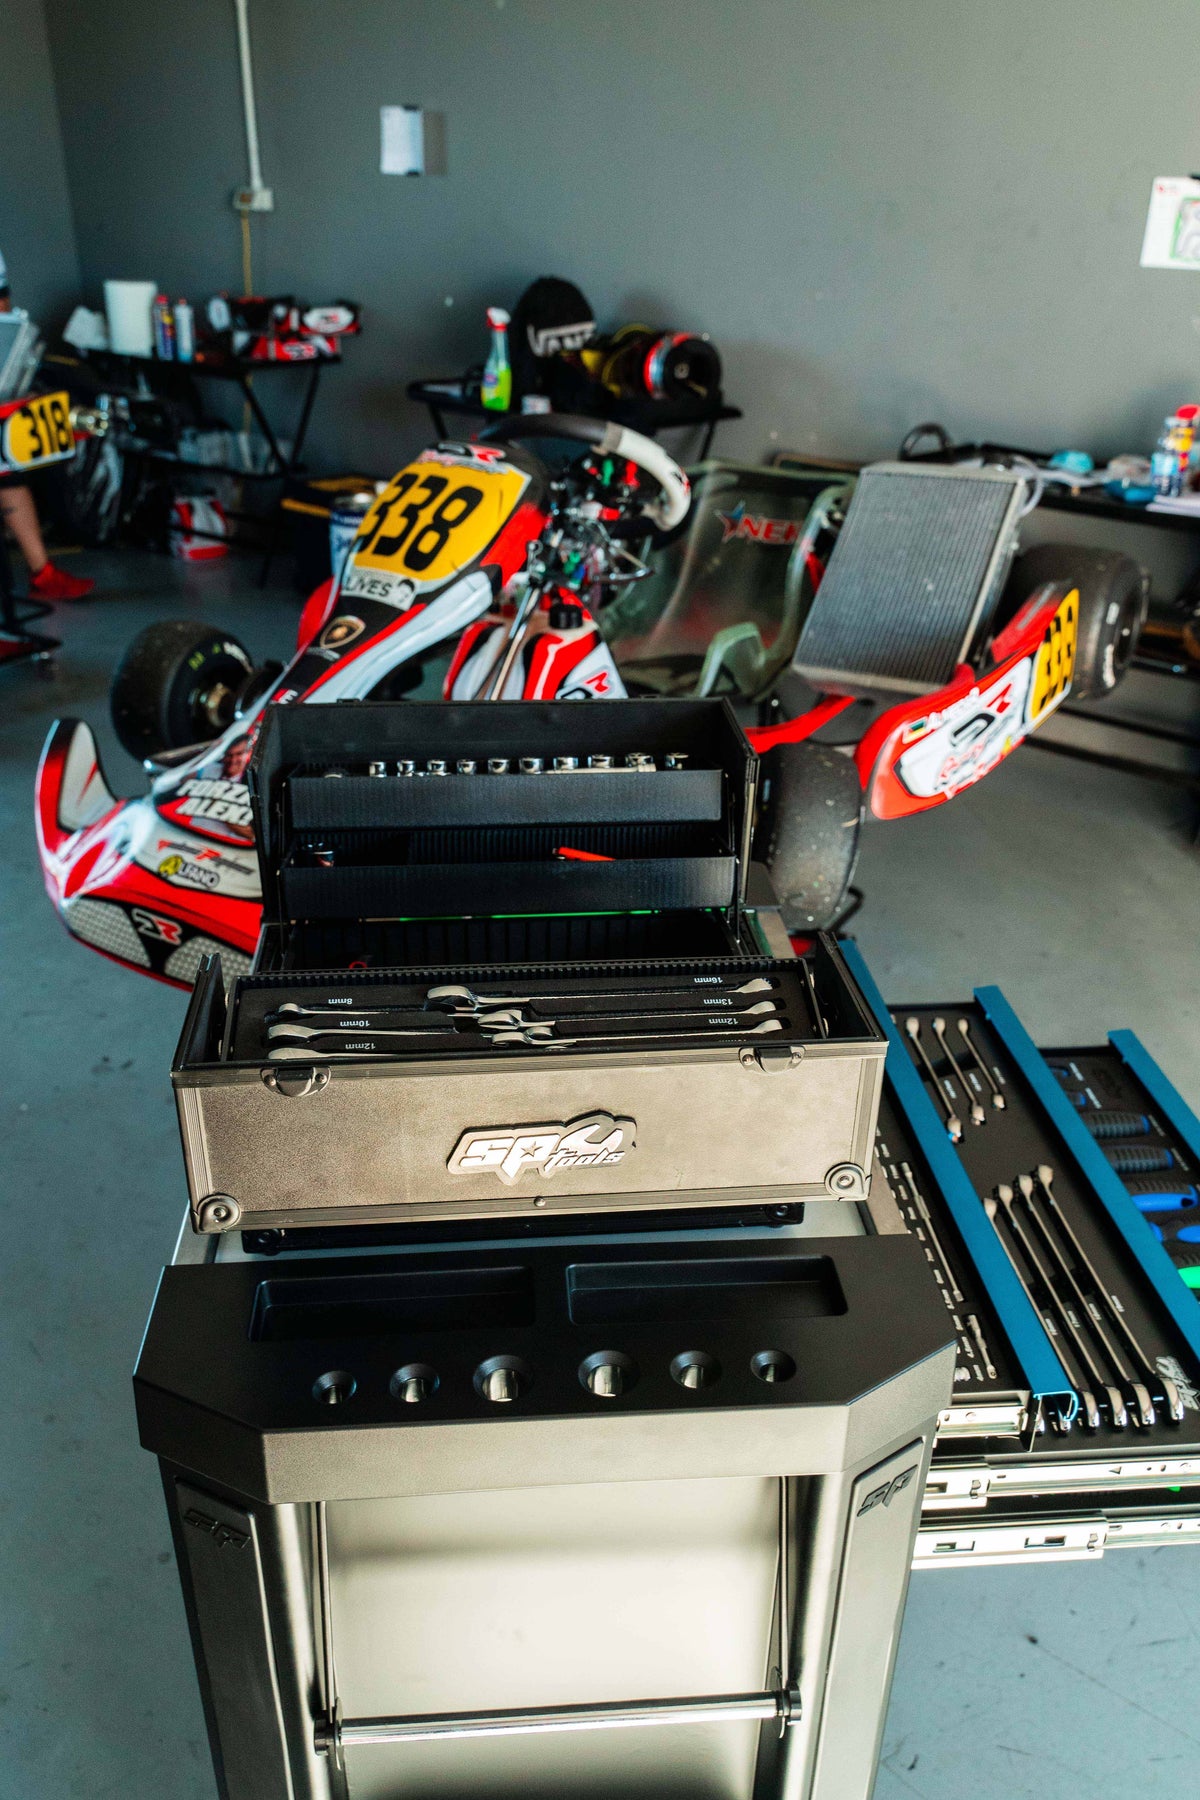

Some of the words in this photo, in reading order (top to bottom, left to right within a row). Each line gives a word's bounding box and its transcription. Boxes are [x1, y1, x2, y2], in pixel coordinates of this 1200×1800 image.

[20, 400, 70, 458] 318
[358, 473, 484, 572] 338
[328, 997, 353, 1005] 8mm
[703, 998, 733, 1006] 13mm
[339, 1019, 370, 1028] 10mm
[708, 1017, 739, 1025] 12mm
[345, 1042, 376, 1050] 12mm
[458, 1132, 561, 1179] SP
